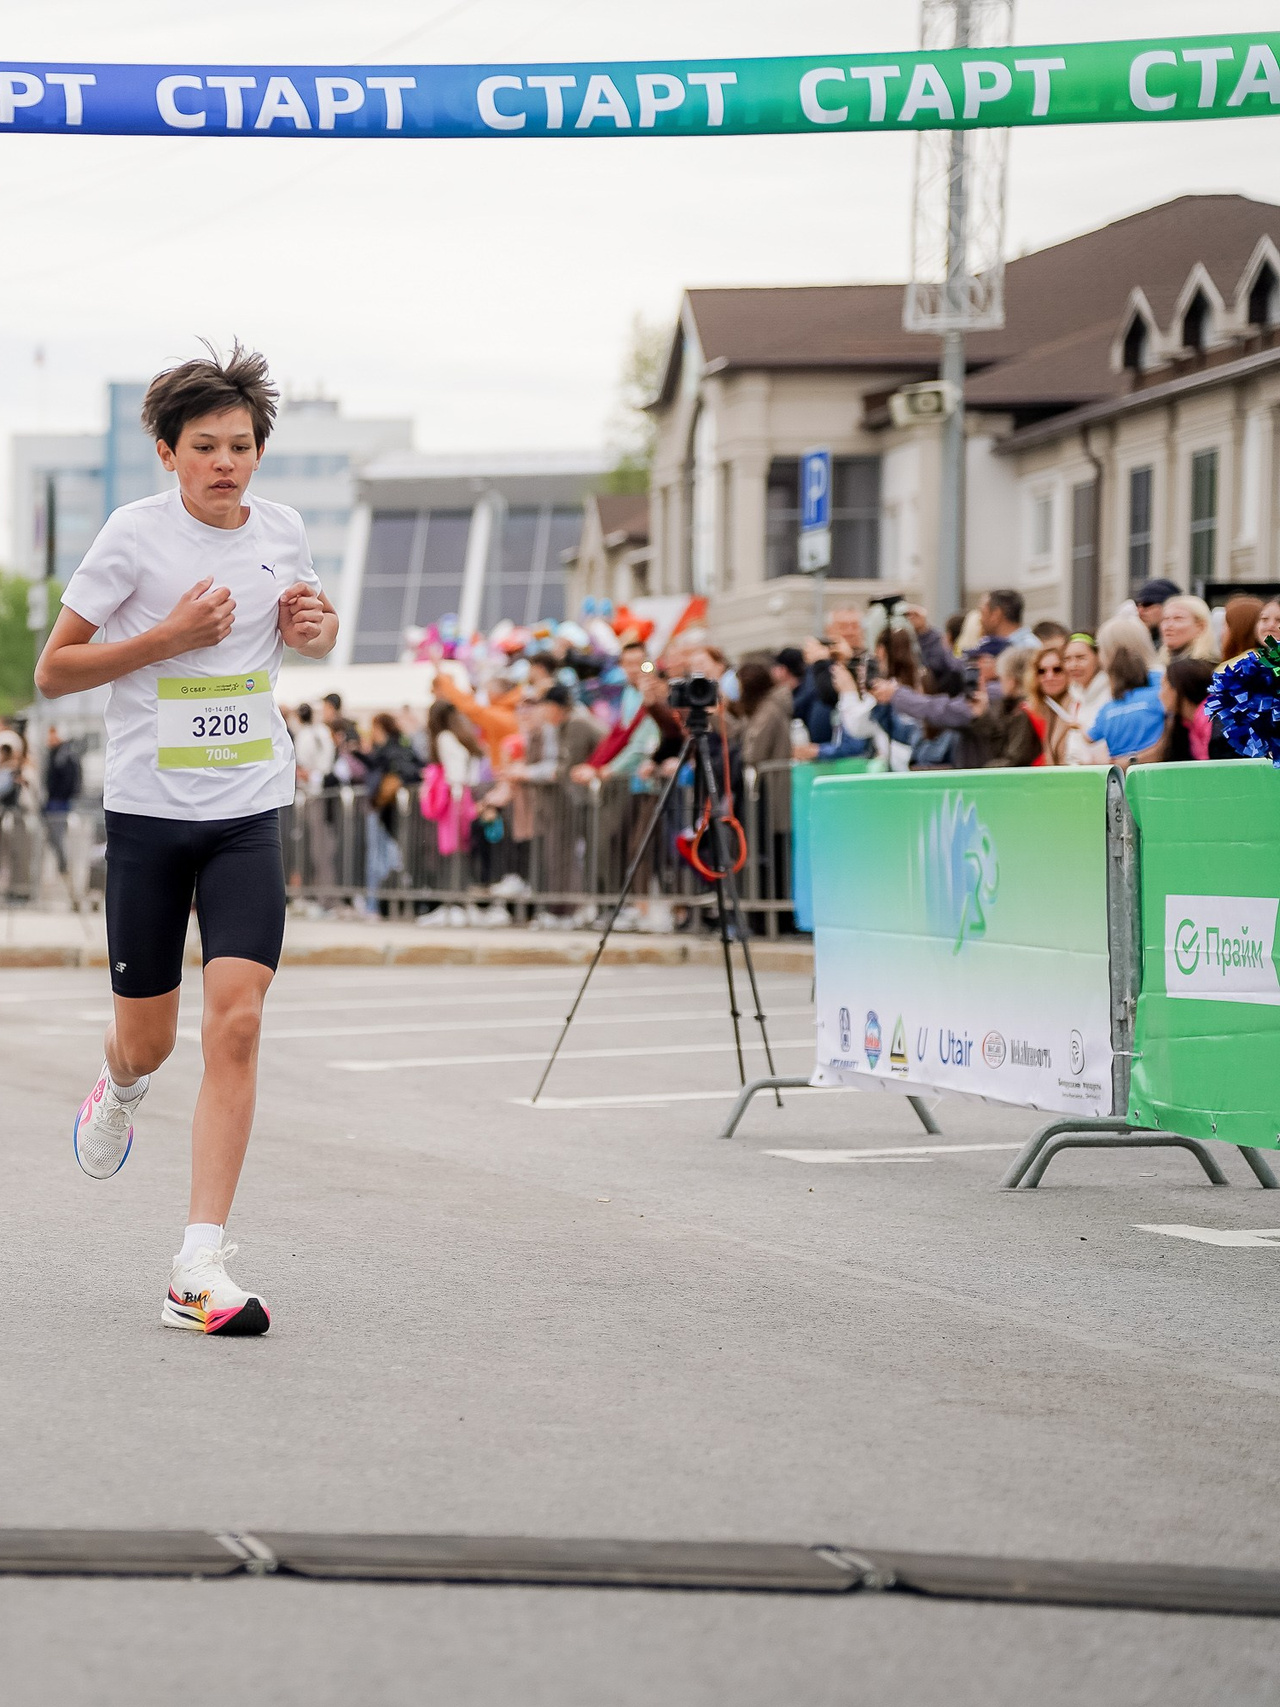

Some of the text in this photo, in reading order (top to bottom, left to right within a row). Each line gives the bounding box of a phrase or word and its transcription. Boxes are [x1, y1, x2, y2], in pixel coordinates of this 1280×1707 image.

[156, 75, 417, 130] СТАРТ
[477, 72, 738, 129] СТАРТ
[800, 58, 1065, 123] СТАРТ
[192, 713, 249, 738] 3208
[1206, 926, 1264, 976] Прайм
[939, 1029, 973, 1068] Utair
